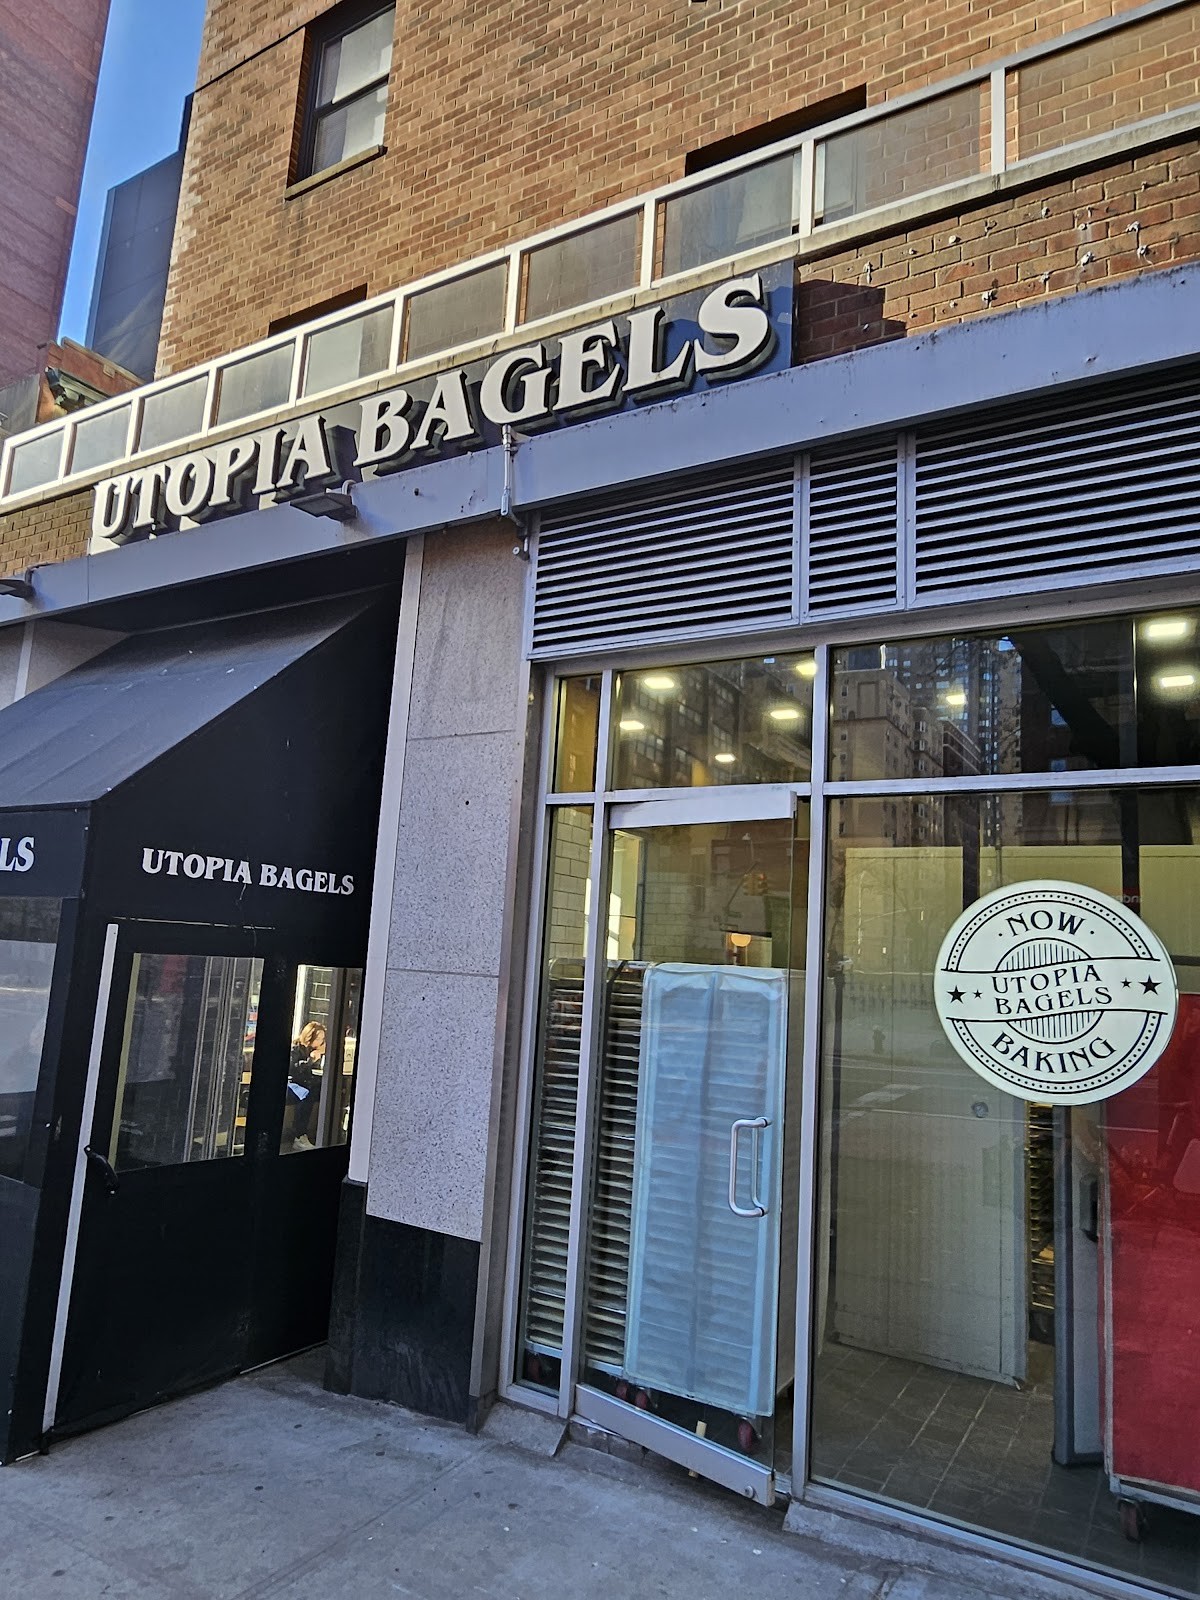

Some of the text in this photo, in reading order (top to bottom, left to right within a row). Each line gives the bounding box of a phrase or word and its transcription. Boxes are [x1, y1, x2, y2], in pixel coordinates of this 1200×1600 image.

[92, 273, 772, 538] UTOPIA BAGELS
[142, 847, 355, 896] UTOPIA BAGELS
[1006, 910, 1086, 936] NOW
[992, 964, 1102, 994] UTOPIA
[995, 986, 1113, 1015] BAGELS
[991, 1031, 1117, 1074] BAKING
